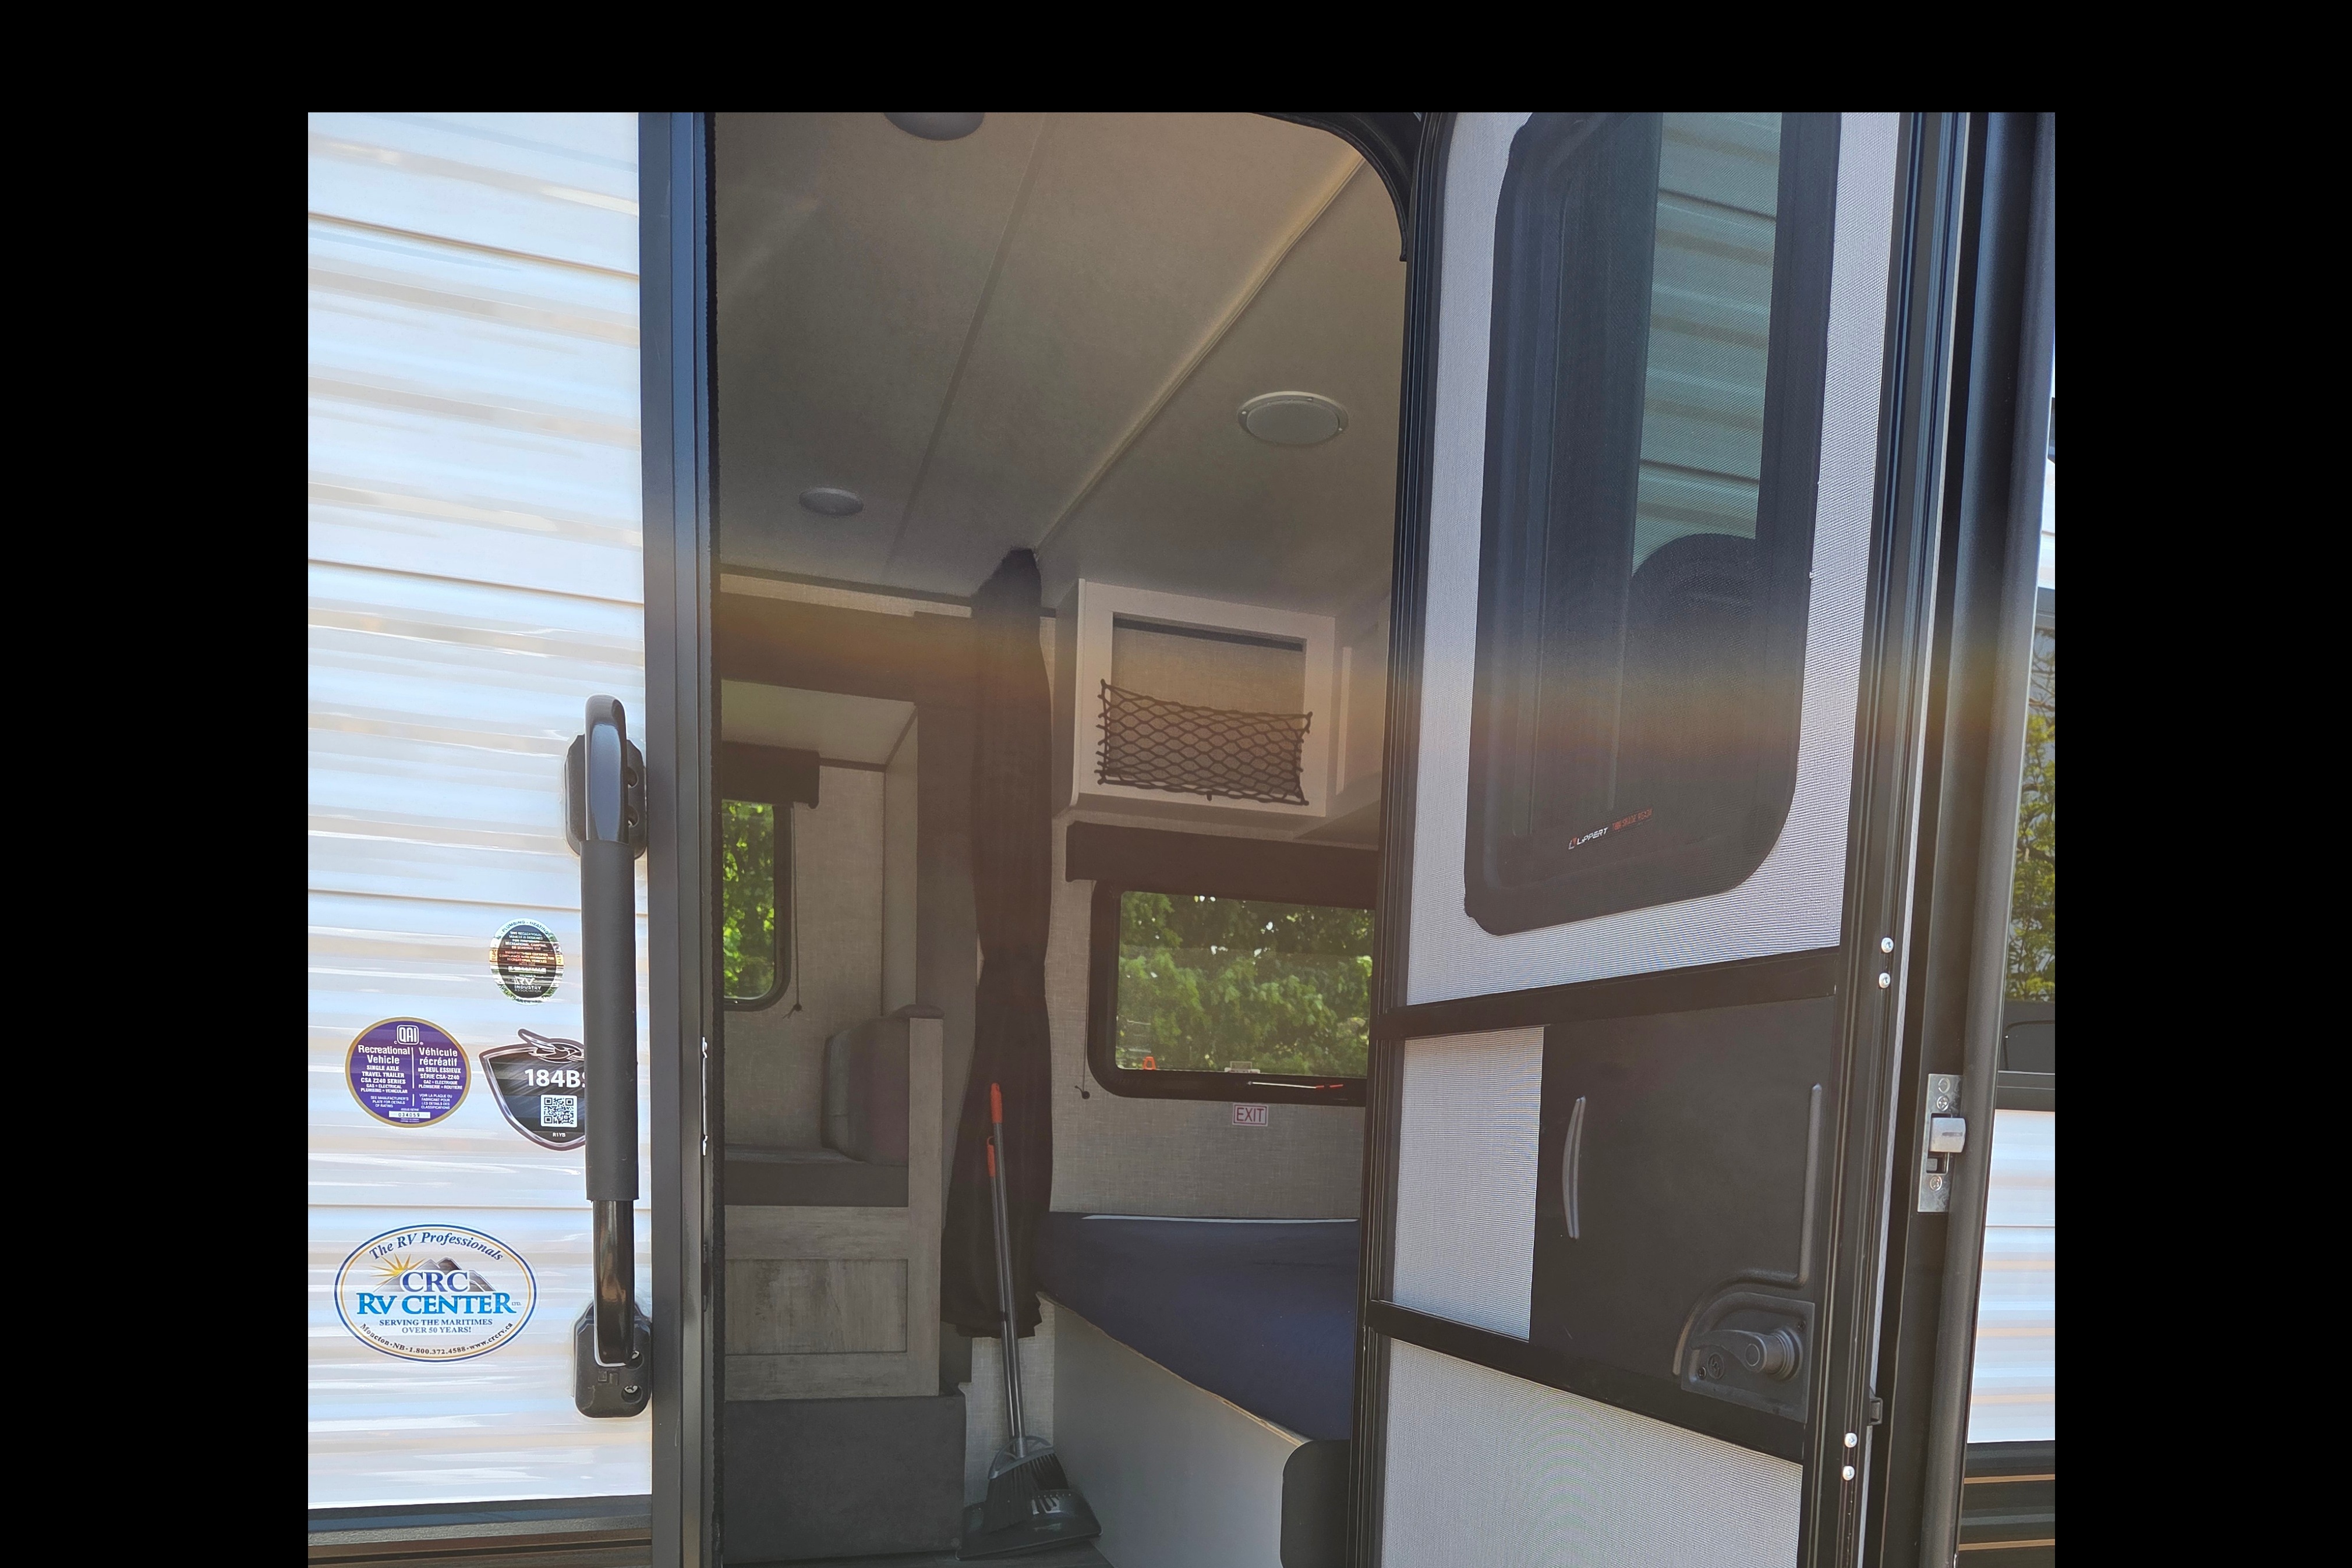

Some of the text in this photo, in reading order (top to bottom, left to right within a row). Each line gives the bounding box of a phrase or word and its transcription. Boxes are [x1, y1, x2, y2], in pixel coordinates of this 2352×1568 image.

[1577, 827, 1608, 845] LIPPERT
[502, 921, 525, 933] PLUMBING
[399, 1027, 417, 1042] QAI
[358, 1045, 410, 1055] Recreational
[419, 1047, 458, 1056] Véhicule
[367, 1055, 399, 1064] Vehicle
[419, 1057, 458, 1067] récréatif
[524, 1068, 586, 1088] 184B
[1236, 1107, 1264, 1123] EXIT
[369, 1232, 504, 1261] The RV Professionals
[402, 1272, 468, 1293] CRC
[356, 1292, 397, 1315] RV
[402, 1292, 517, 1315] CENTER
[441, 1318, 493, 1326] MARITIMES
